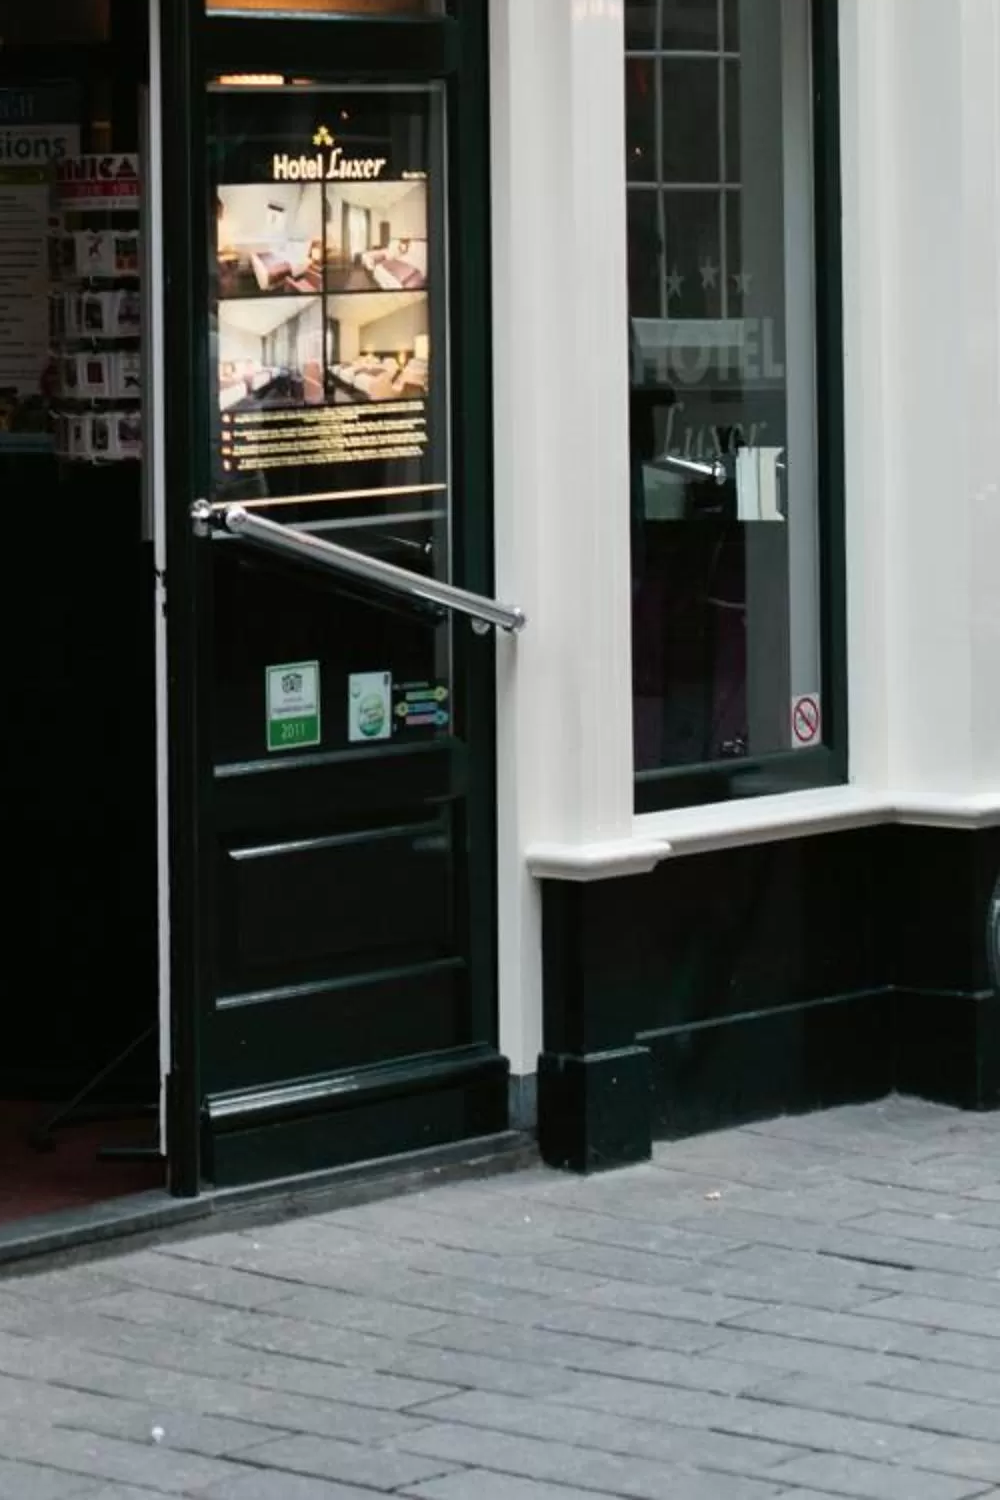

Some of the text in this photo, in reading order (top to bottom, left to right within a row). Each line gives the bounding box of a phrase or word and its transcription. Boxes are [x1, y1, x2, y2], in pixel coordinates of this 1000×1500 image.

[272, 147, 387, 180] Hotel Luxer
[631, 316, 784, 385] HOTEL
[280, 723, 306, 740] 2011
